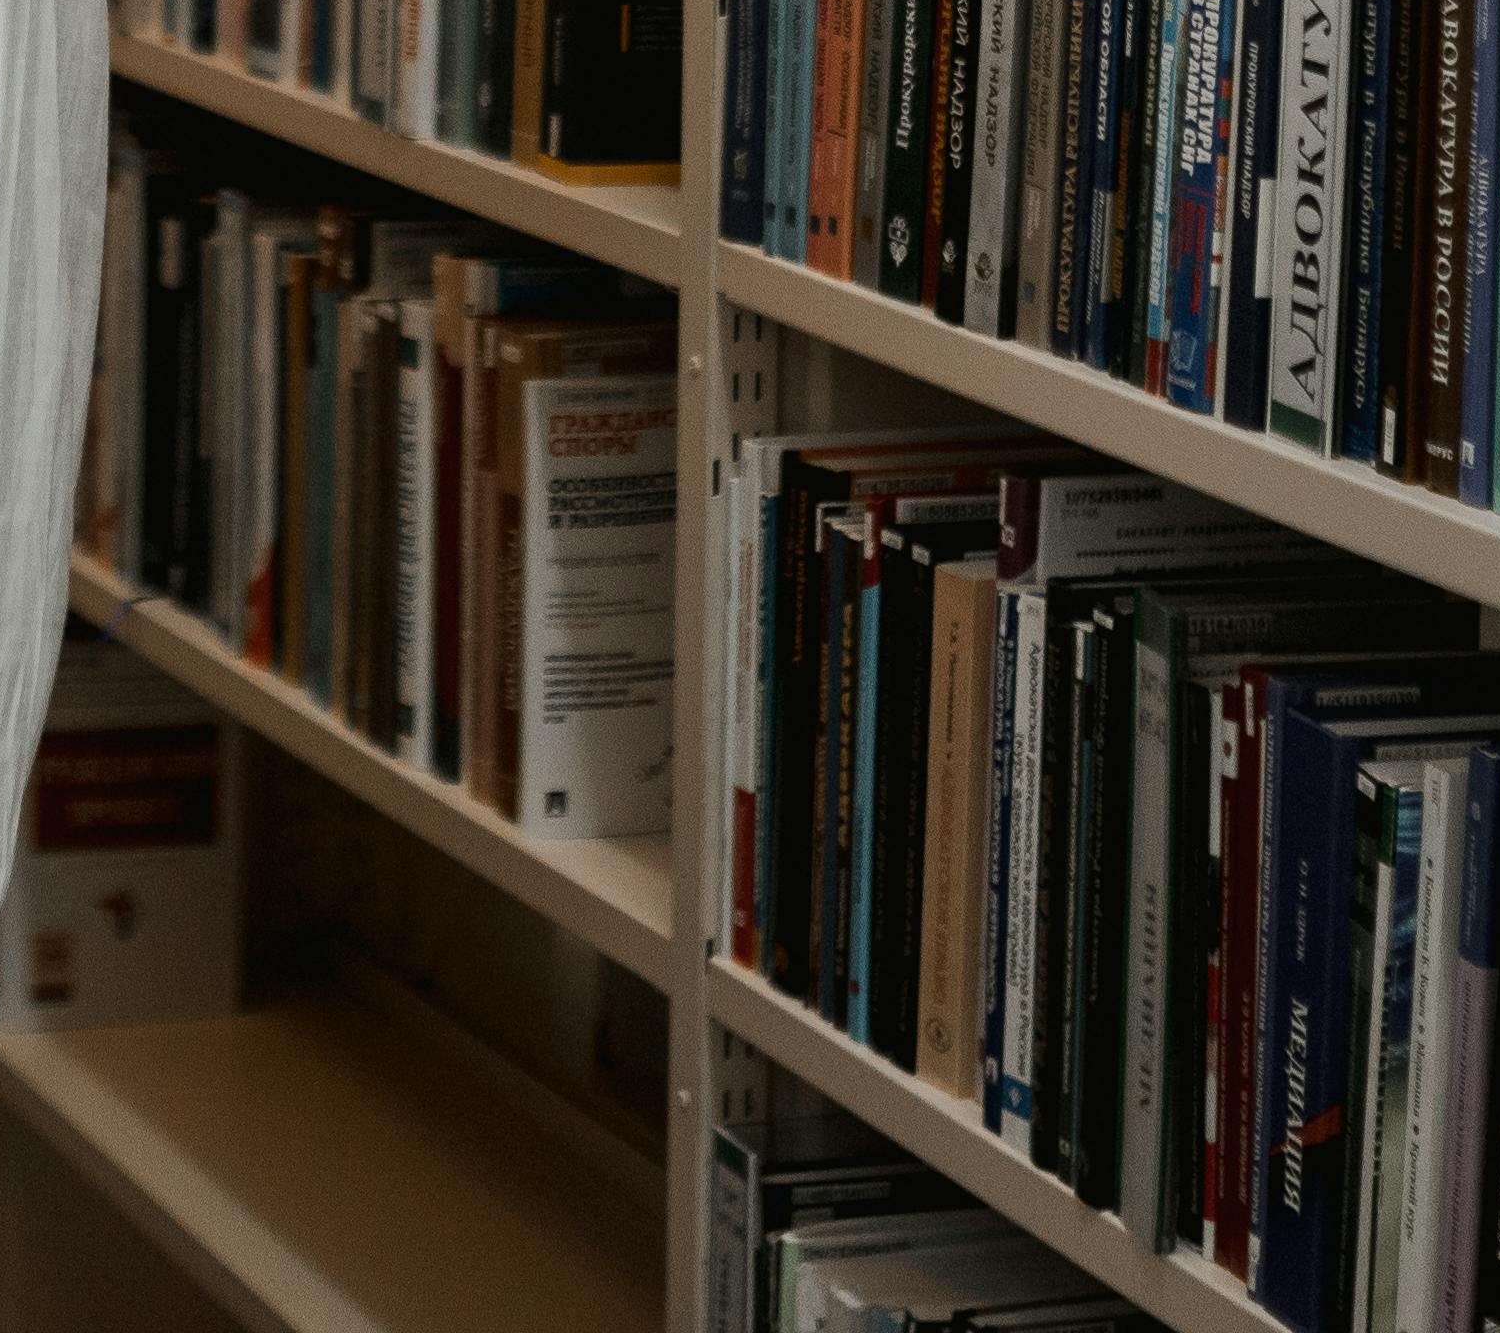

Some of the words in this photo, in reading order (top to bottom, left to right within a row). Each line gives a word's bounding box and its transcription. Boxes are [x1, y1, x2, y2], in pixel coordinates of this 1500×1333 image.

[868, 50, 881, 128] НАДЗОР
[949, 57, 964, 171] НАДЗОР
[984, 66, 1000, 168] НАДЗОР
[1096, 39, 1110, 142] ОБЛАСТИ
[1183, 9, 1203, 120] СТРАНАХ
[1244, 41, 1259, 158] ПРОКУРОРСКИЙ
[1365, 89, 1374, 106] в
[931, 111, 947, 227] НАДЗОР
[1155, 41, 1174, 214] Прокурорский
[1181, 126, 1195, 177] СНГ
[1397, 130, 1407, 144] в
[1241, 159, 1252, 220] НАДЗОР
[1358, 118, 1377, 275] Республике
[1391, 153, 1408, 252] России
[1436, 205, 1454, 228] В
[1475, 153, 1490, 276] АДВОКАТУРА
[1055, 164, 1077, 335] ПРОКУРАТУРА
[1149, 219, 1163, 308] надзор
[1352, 286, 1371, 411] Беларусь
[1429, 234, 1453, 388] РОССИИ
[1027, 641, 1041, 753] Адвокатская
[1024, 756, 1038, 877] деятельность
[1282, 996, 1309, 1216] МЕДИАЦИЯ
